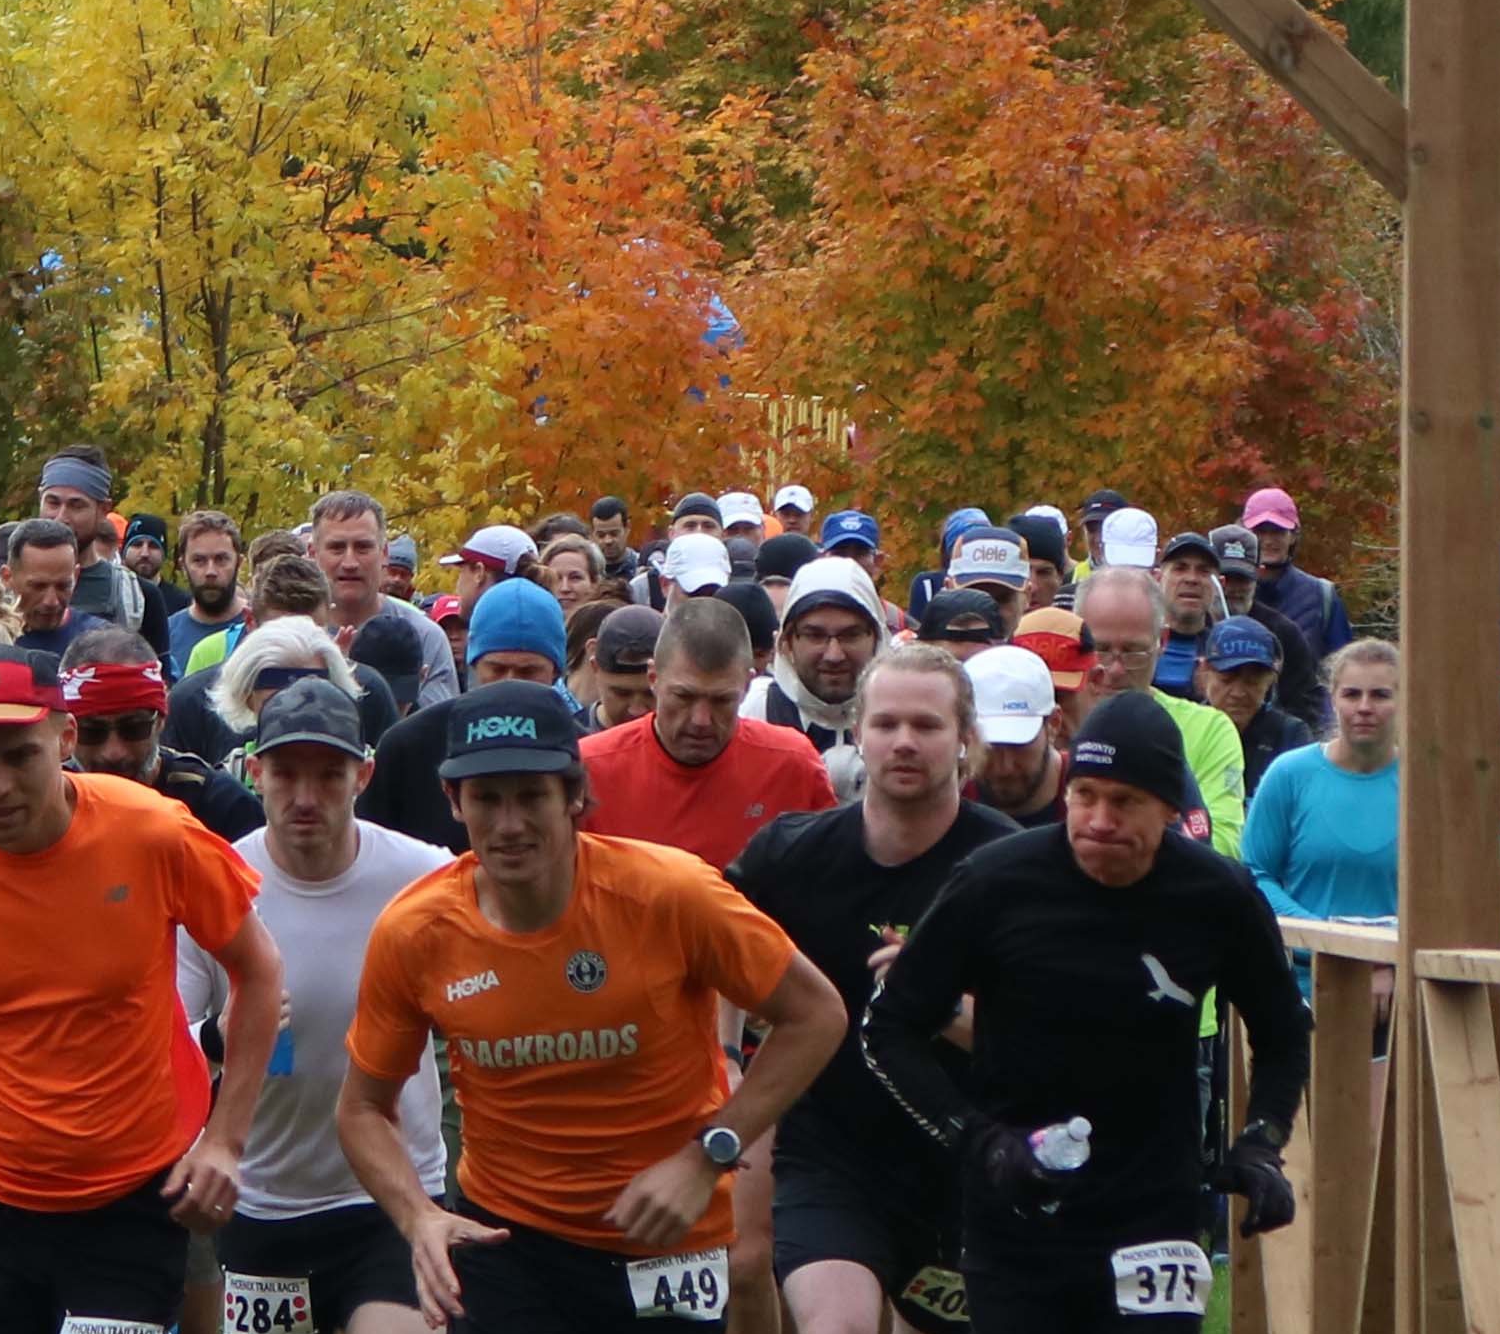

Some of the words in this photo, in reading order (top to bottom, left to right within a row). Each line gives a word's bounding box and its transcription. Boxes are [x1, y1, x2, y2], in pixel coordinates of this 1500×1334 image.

[972, 544, 1008, 563] ciele
[466, 715, 537, 744] HOKA
[446, 970, 500, 1002] HOKA
[653, 1267, 718, 1313] 449
[1135, 1264, 1197, 1305] 375
[235, 1295, 295, 1334] 284
